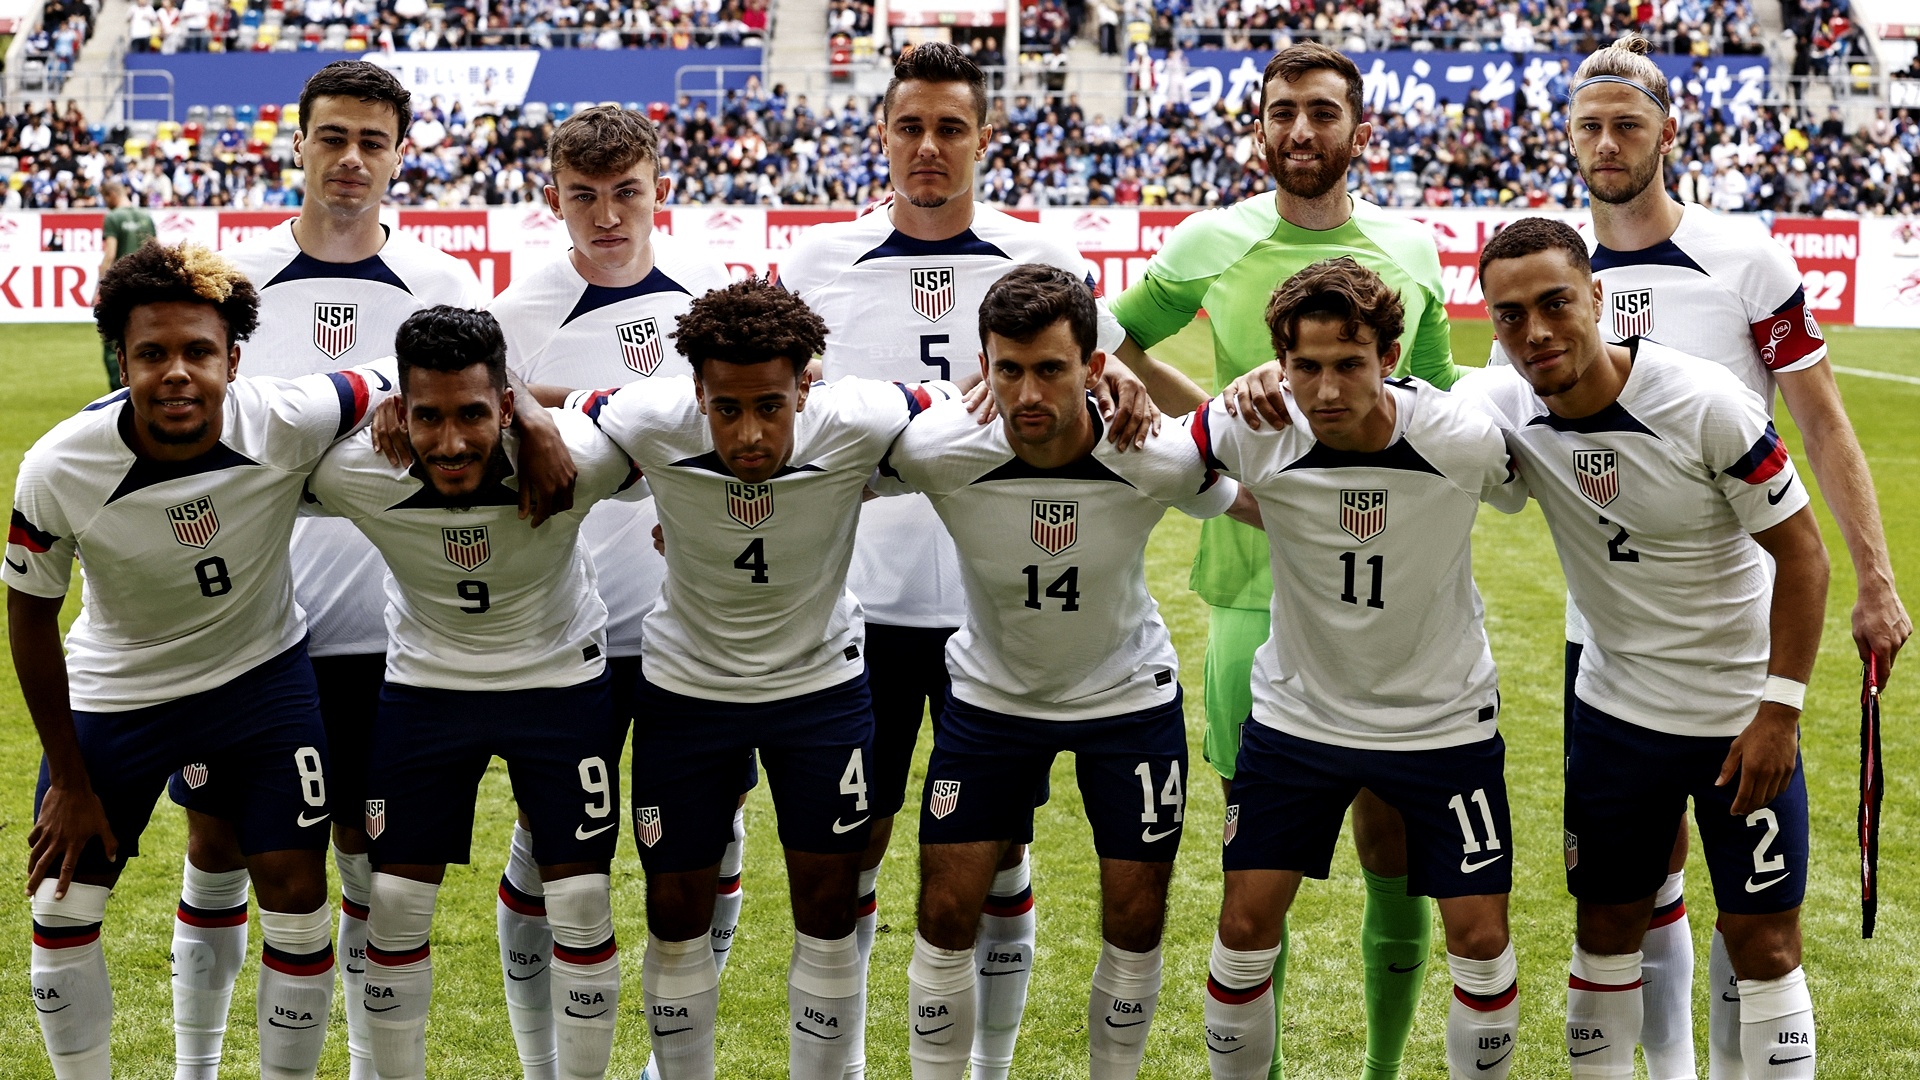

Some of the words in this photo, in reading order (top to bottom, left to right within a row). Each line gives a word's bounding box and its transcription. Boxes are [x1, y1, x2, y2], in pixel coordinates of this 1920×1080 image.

[401, 225, 486, 252] KIRIN
[1774, 233, 1857, 259] KIRIN
[0, 266, 94, 308] KIR
[914, 270, 951, 291] USA
[1615, 291, 1650, 314] USA
[318, 306, 354, 327] USA
[620, 321, 656, 345] USA
[1774, 324, 1789, 335] USA
[920, 334, 950, 384] 5
[1576, 452, 1616, 476] USA
[730, 482, 769, 500] USA
[1343, 491, 1384, 511] USA
[170, 496, 210, 521] USA
[1036, 503, 1074, 525] USA
[446, 529, 485, 547] USA
[1598, 515, 1639, 562] 2
[734, 537, 769, 584] 4
[194, 556, 232, 598] 8
[1339, 551, 1384, 609] 11
[456, 580, 489, 614] 9
[1022, 565, 1080, 612] 14
[295, 746, 326, 806] 8
[839, 748, 868, 811] 4
[577, 756, 611, 818] 9
[934, 781, 960, 797] USA
[1134, 759, 1183, 822] 14
[366, 800, 384, 817] USA
[637, 808, 658, 824] USA
[1448, 788, 1502, 854] 11
[1745, 807, 1785, 874] 2
[349, 947, 366, 960] US
[509, 950, 542, 966] USA
[987, 951, 1023, 963] USA
[365, 982, 395, 998] USA
[570, 990, 605, 1005] USA
[275, 1005, 313, 1021] USA
[653, 1005, 689, 1018] USA
[918, 1005, 949, 1018] USA
[1112, 999, 1143, 1014] USA
[804, 1007, 838, 1028] USA
[1478, 1033, 1511, 1050] USA
[1571, 1028, 1604, 1041] USA
[1779, 1032, 1809, 1045] USA
